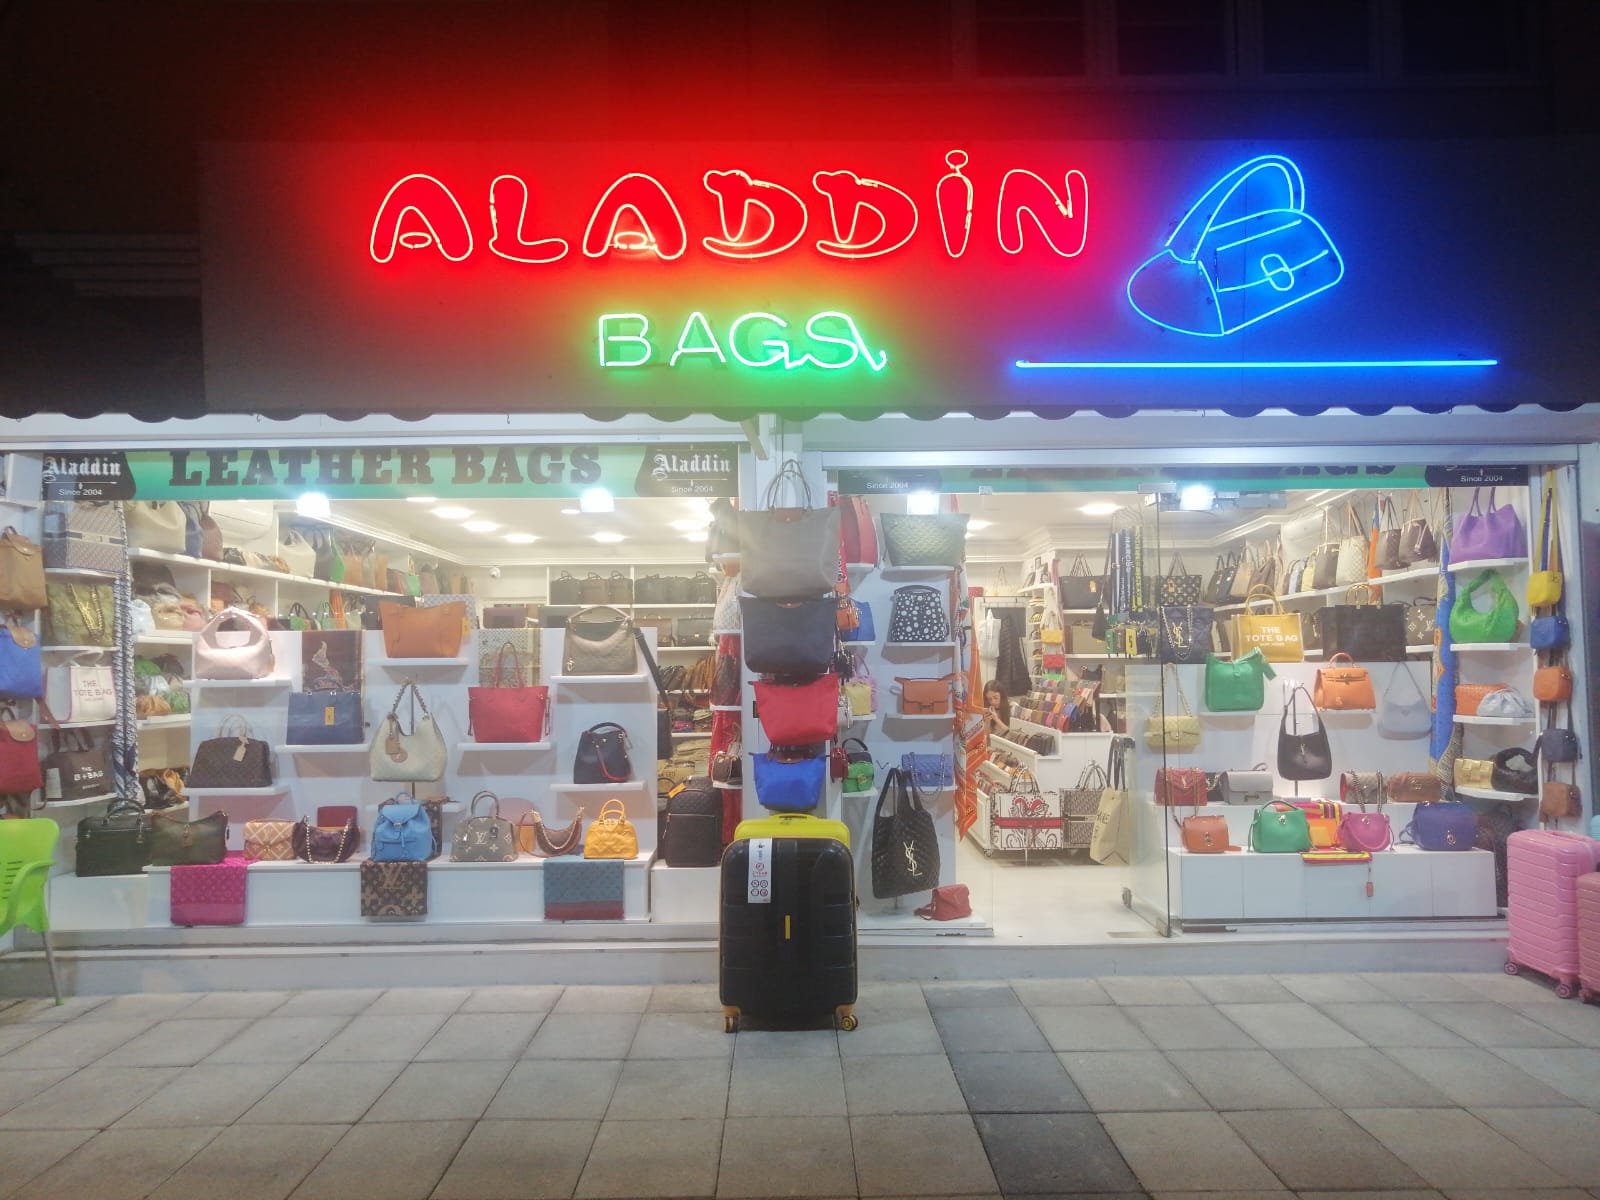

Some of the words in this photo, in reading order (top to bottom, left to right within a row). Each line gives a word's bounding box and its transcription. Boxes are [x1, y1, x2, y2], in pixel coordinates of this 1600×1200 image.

[598, 311, 887, 371] BAGS
[43, 456, 121, 481] Aladdin
[169, 447, 434, 487] LEATHER
[451, 445, 602, 485] BAGS
[650, 453, 730, 481] Aladdin
[1483, 474, 1503, 482] 2004
[671, 485, 693, 493] Since
[694, 485, 713, 493] 2004
[865, 481, 888, 489] Since
[889, 480, 909, 489] 2004
[58, 488, 80, 496] Since
[82, 488, 103, 496] 2004
[1262, 626, 1281, 634] THE
[1245, 634, 1273, 642] TOTE
[1275, 634, 1299, 642] BAG
[80, 680, 97, 688] THE
[74, 689, 94, 697] TOTE
[95, 688, 113, 696] BAG
[902, 840, 923, 877] YSL
